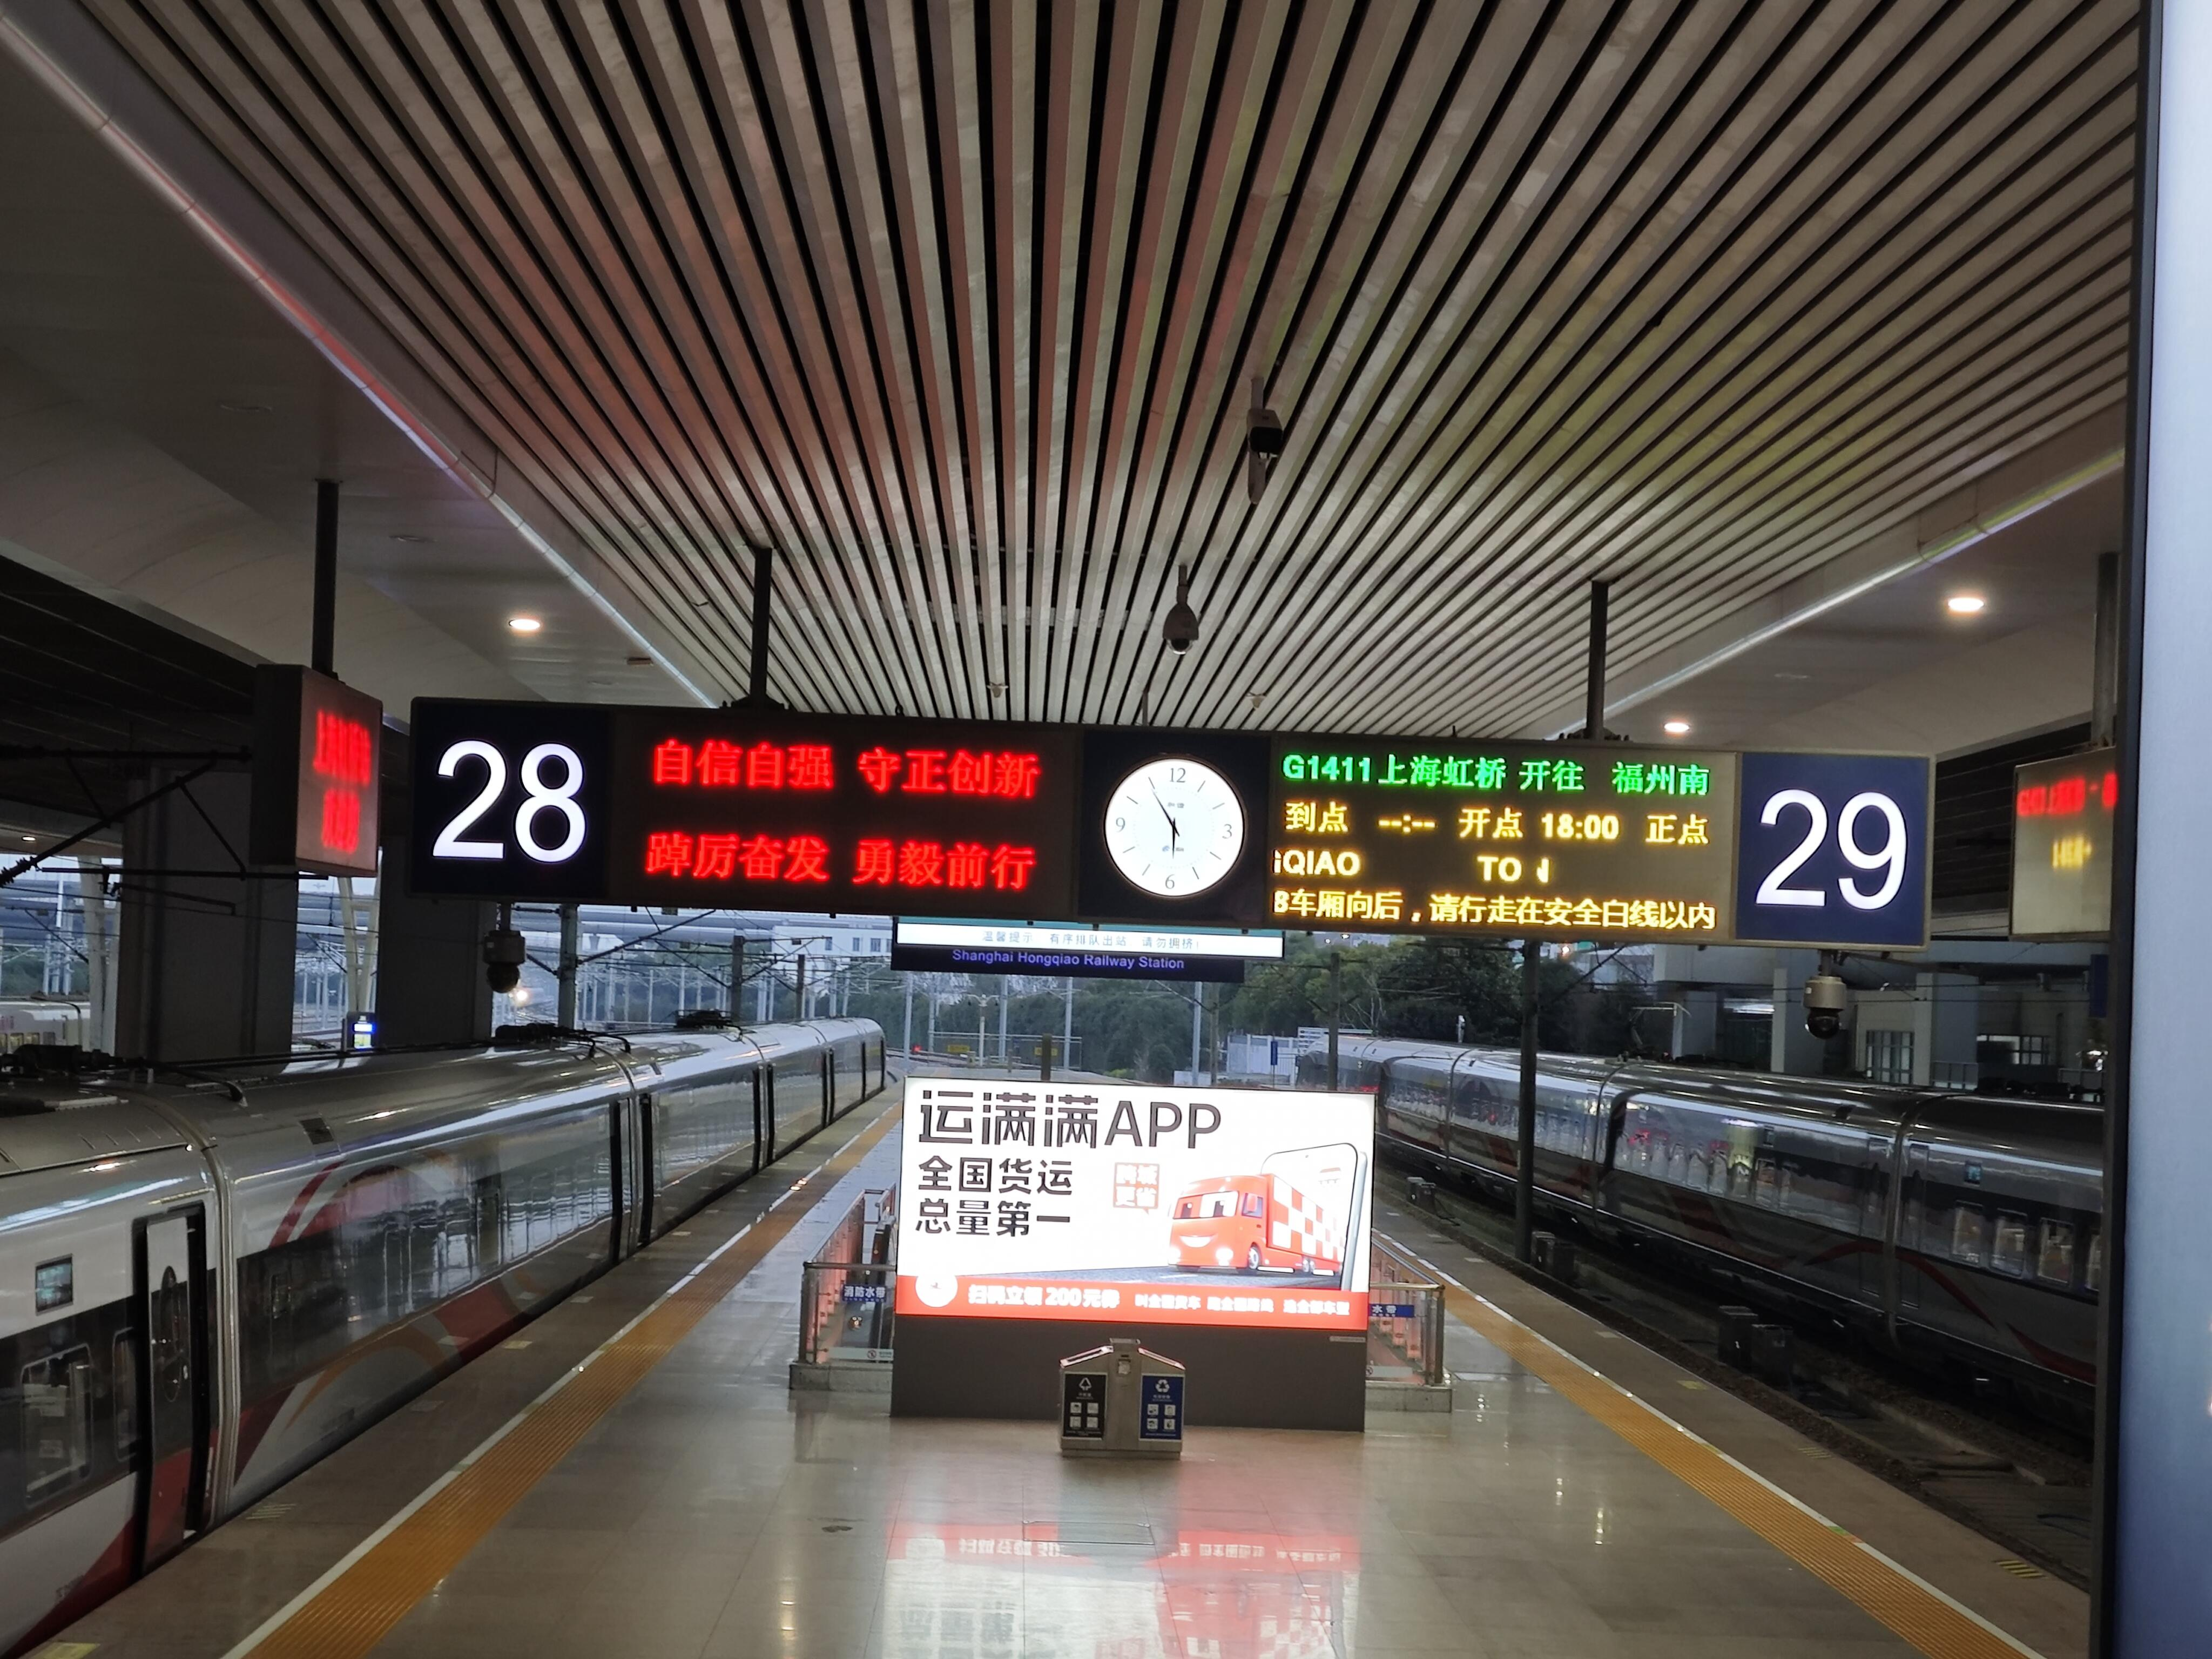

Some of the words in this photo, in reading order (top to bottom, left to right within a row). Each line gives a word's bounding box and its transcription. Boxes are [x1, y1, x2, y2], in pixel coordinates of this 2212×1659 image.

[653, 738, 834, 790] 自信自强
[857, 747, 1041, 799] 守正创新
[1170, 768, 1186, 783] 12
[1519, 760, 1584, 791] 开往
[1611, 761, 1710, 795] 福州南
[433, 740, 586, 862] 28
[1116, 817, 1125, 832] 9
[1222, 824, 1232, 839] 3
[1286, 801, 1348, 832] 到点
[1459, 807, 1523, 839] 开点
[1541, 813, 1620, 840] 18:00
[1645, 814, 1709, 845] 正点
[645, 832, 830, 882] 踔厉奋发
[852, 839, 1037, 891] 勇毅前行
[1756, 790, 1906, 909] 29
[1165, 874, 1175, 889] 6
[1477, 856, 1522, 882] TO
[952, 949, 1014, 964] Shanghai
[1018, 952, 1080, 967] Hongqiao
[1084, 954, 1135, 969] Railway
[1138, 956, 1185, 969] Station
[918, 1155, 1073, 1195] 全国货运
[915, 1198, 1071, 1237] 总量第一
